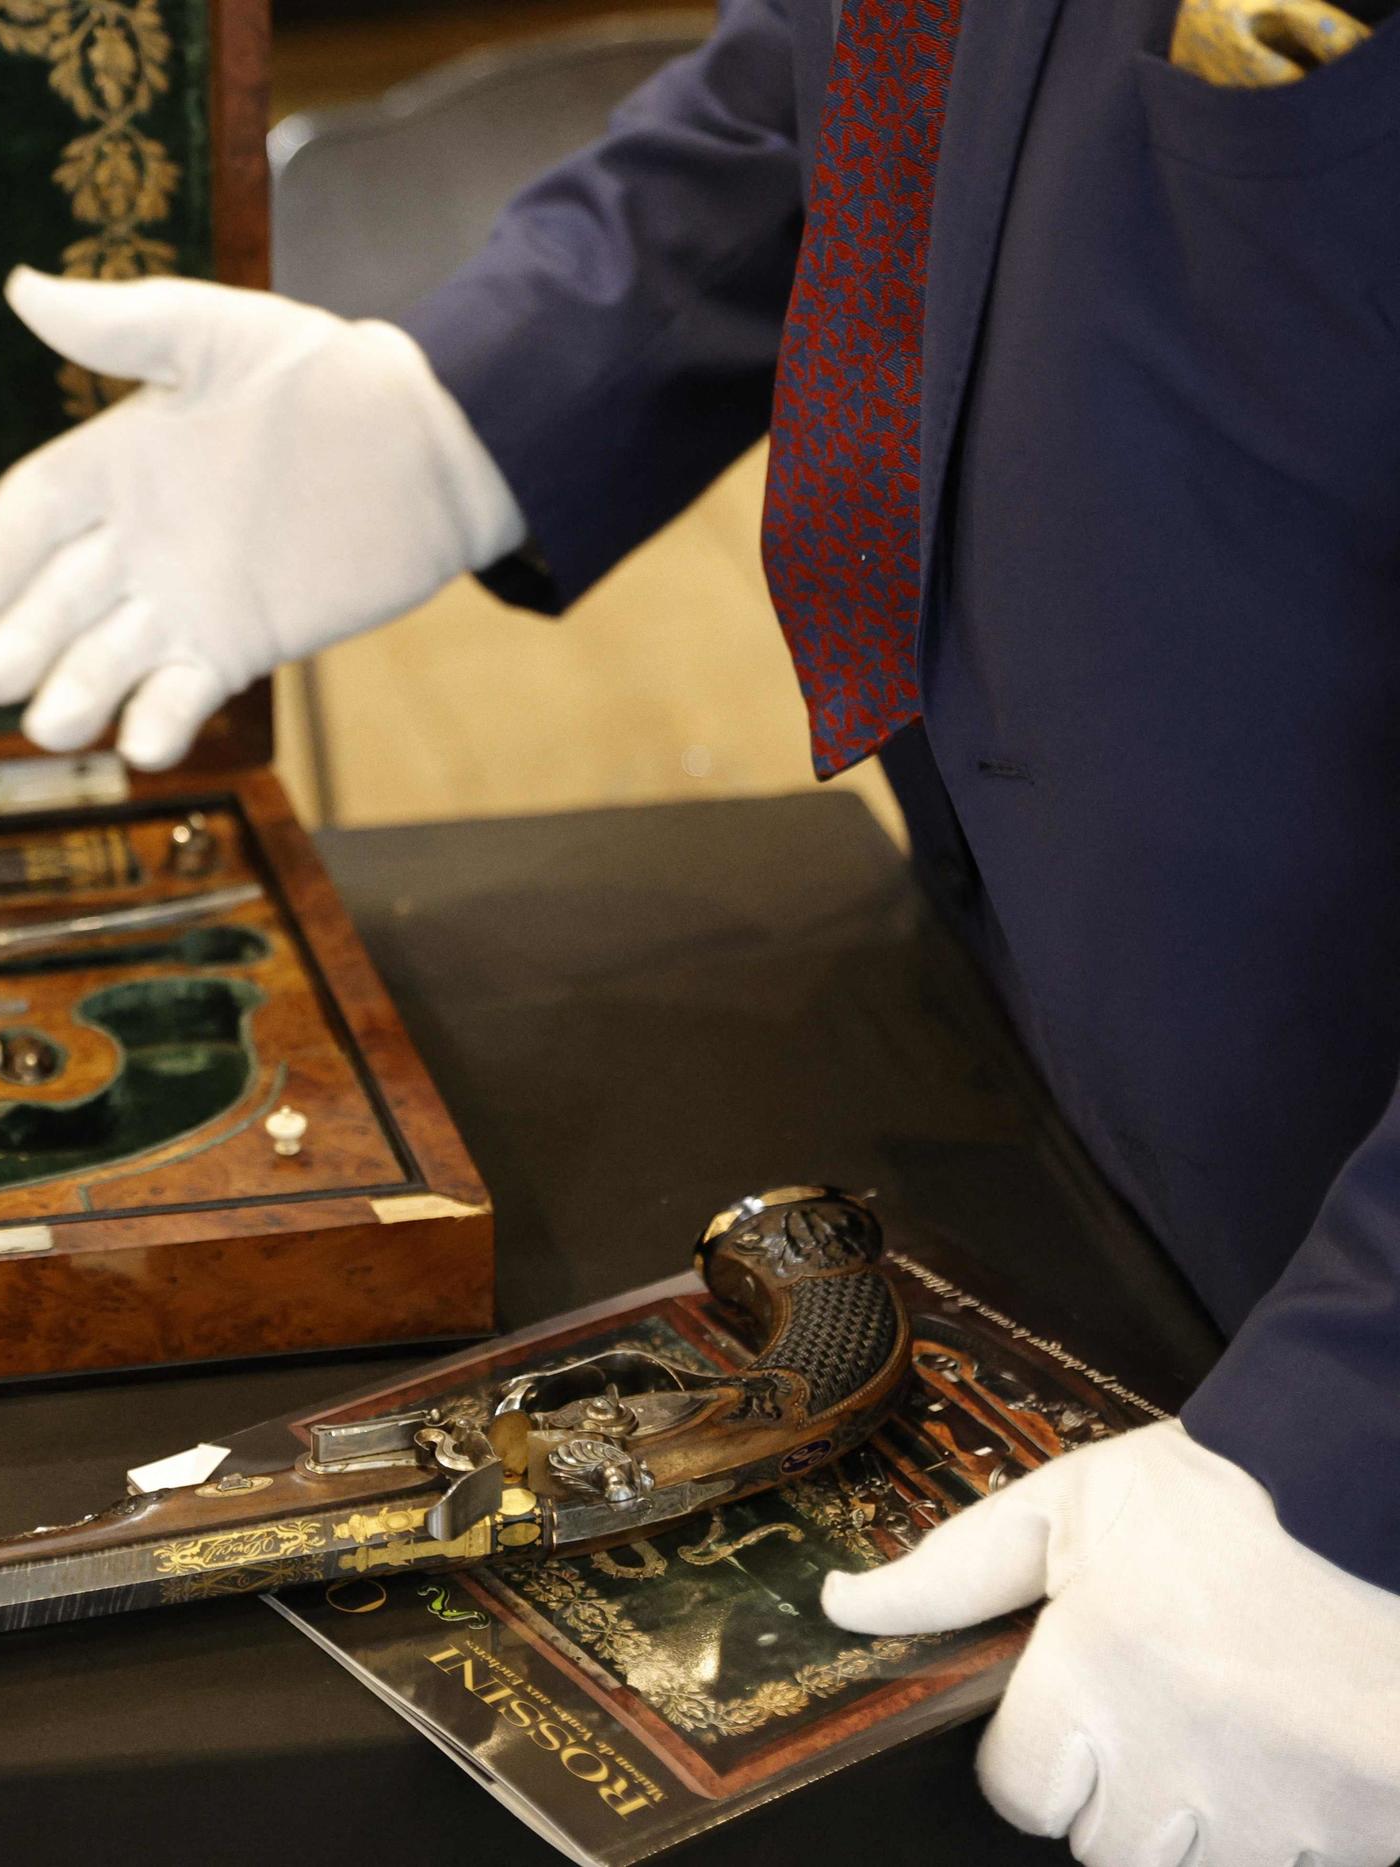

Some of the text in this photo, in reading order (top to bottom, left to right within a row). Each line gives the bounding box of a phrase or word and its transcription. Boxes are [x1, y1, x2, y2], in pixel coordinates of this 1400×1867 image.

[976, 1304, 1017, 1329] cours
[1026, 1336, 1088, 1371] changer
[423, 1643, 655, 1822] ROSSINI
[464, 1639, 669, 1803] Maison de Ventes aux Enchères
